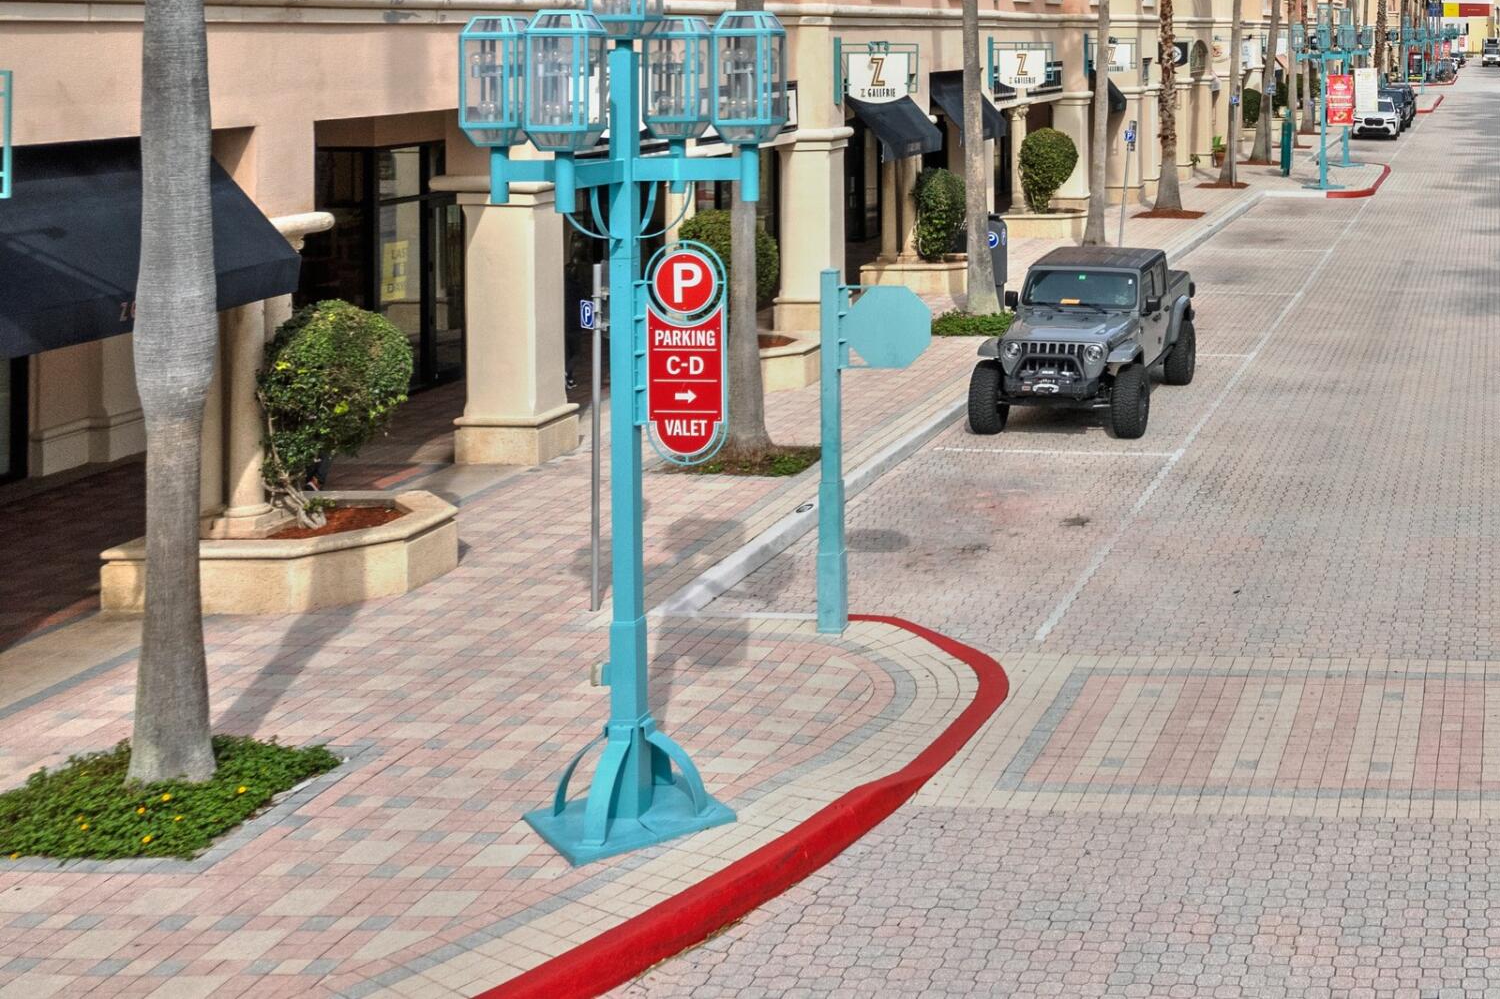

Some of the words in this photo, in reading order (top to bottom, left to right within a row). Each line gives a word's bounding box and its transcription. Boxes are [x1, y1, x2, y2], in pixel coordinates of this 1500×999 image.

[870, 57, 886, 87] Z
[1016, 53, 1028, 76] Z
[867, 88, 896, 98] GALLERIE
[673, 262, 703, 304] P
[584, 305, 592, 323] P
[654, 329, 716, 347] PARKING
[665, 356, 705, 375] C-D
[664, 419, 708, 437] VALET
